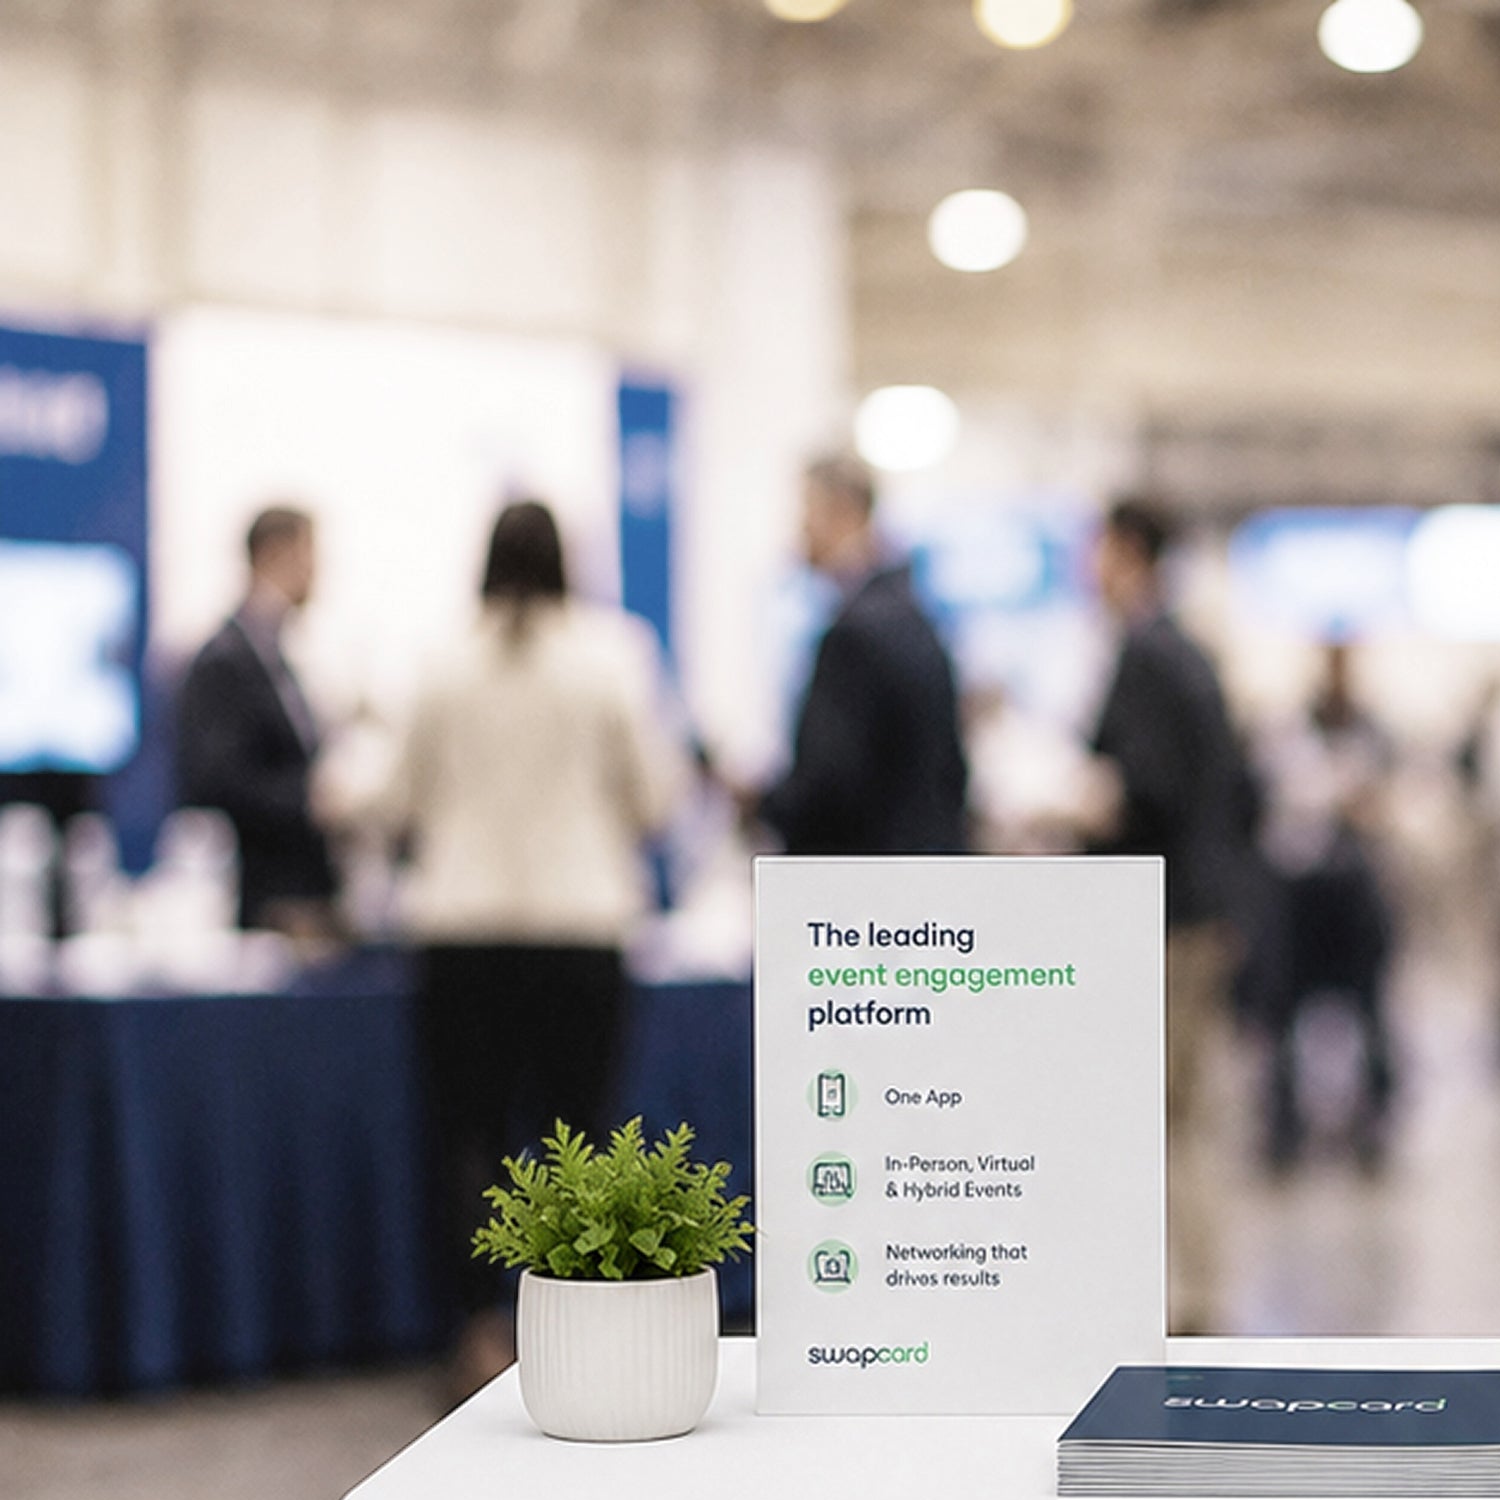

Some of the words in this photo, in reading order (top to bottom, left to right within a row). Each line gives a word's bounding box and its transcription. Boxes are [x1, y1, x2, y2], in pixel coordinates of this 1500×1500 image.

[807, 922, 861, 948] The
[868, 921, 976, 954] leading
[808, 963, 888, 987] event
[895, 963, 1077, 994] engagement
[808, 999, 932, 1032] platform
[884, 1087, 922, 1106] One
[925, 1088, 963, 1109] App
[885, 1155, 974, 1174] In-Person,
[977, 1155, 1036, 1172] Virtual
[885, 1181, 898, 1198] &
[903, 1181, 961, 1203] Hybrid
[964, 1180, 1023, 1198] Events
[886, 1244, 987, 1266] Networking
[991, 1244, 1028, 1261] that
[943, 1270, 1002, 1287] results
[807, 1343, 929, 1370] swapcard
[1164, 1397, 1447, 1413] swapcard
